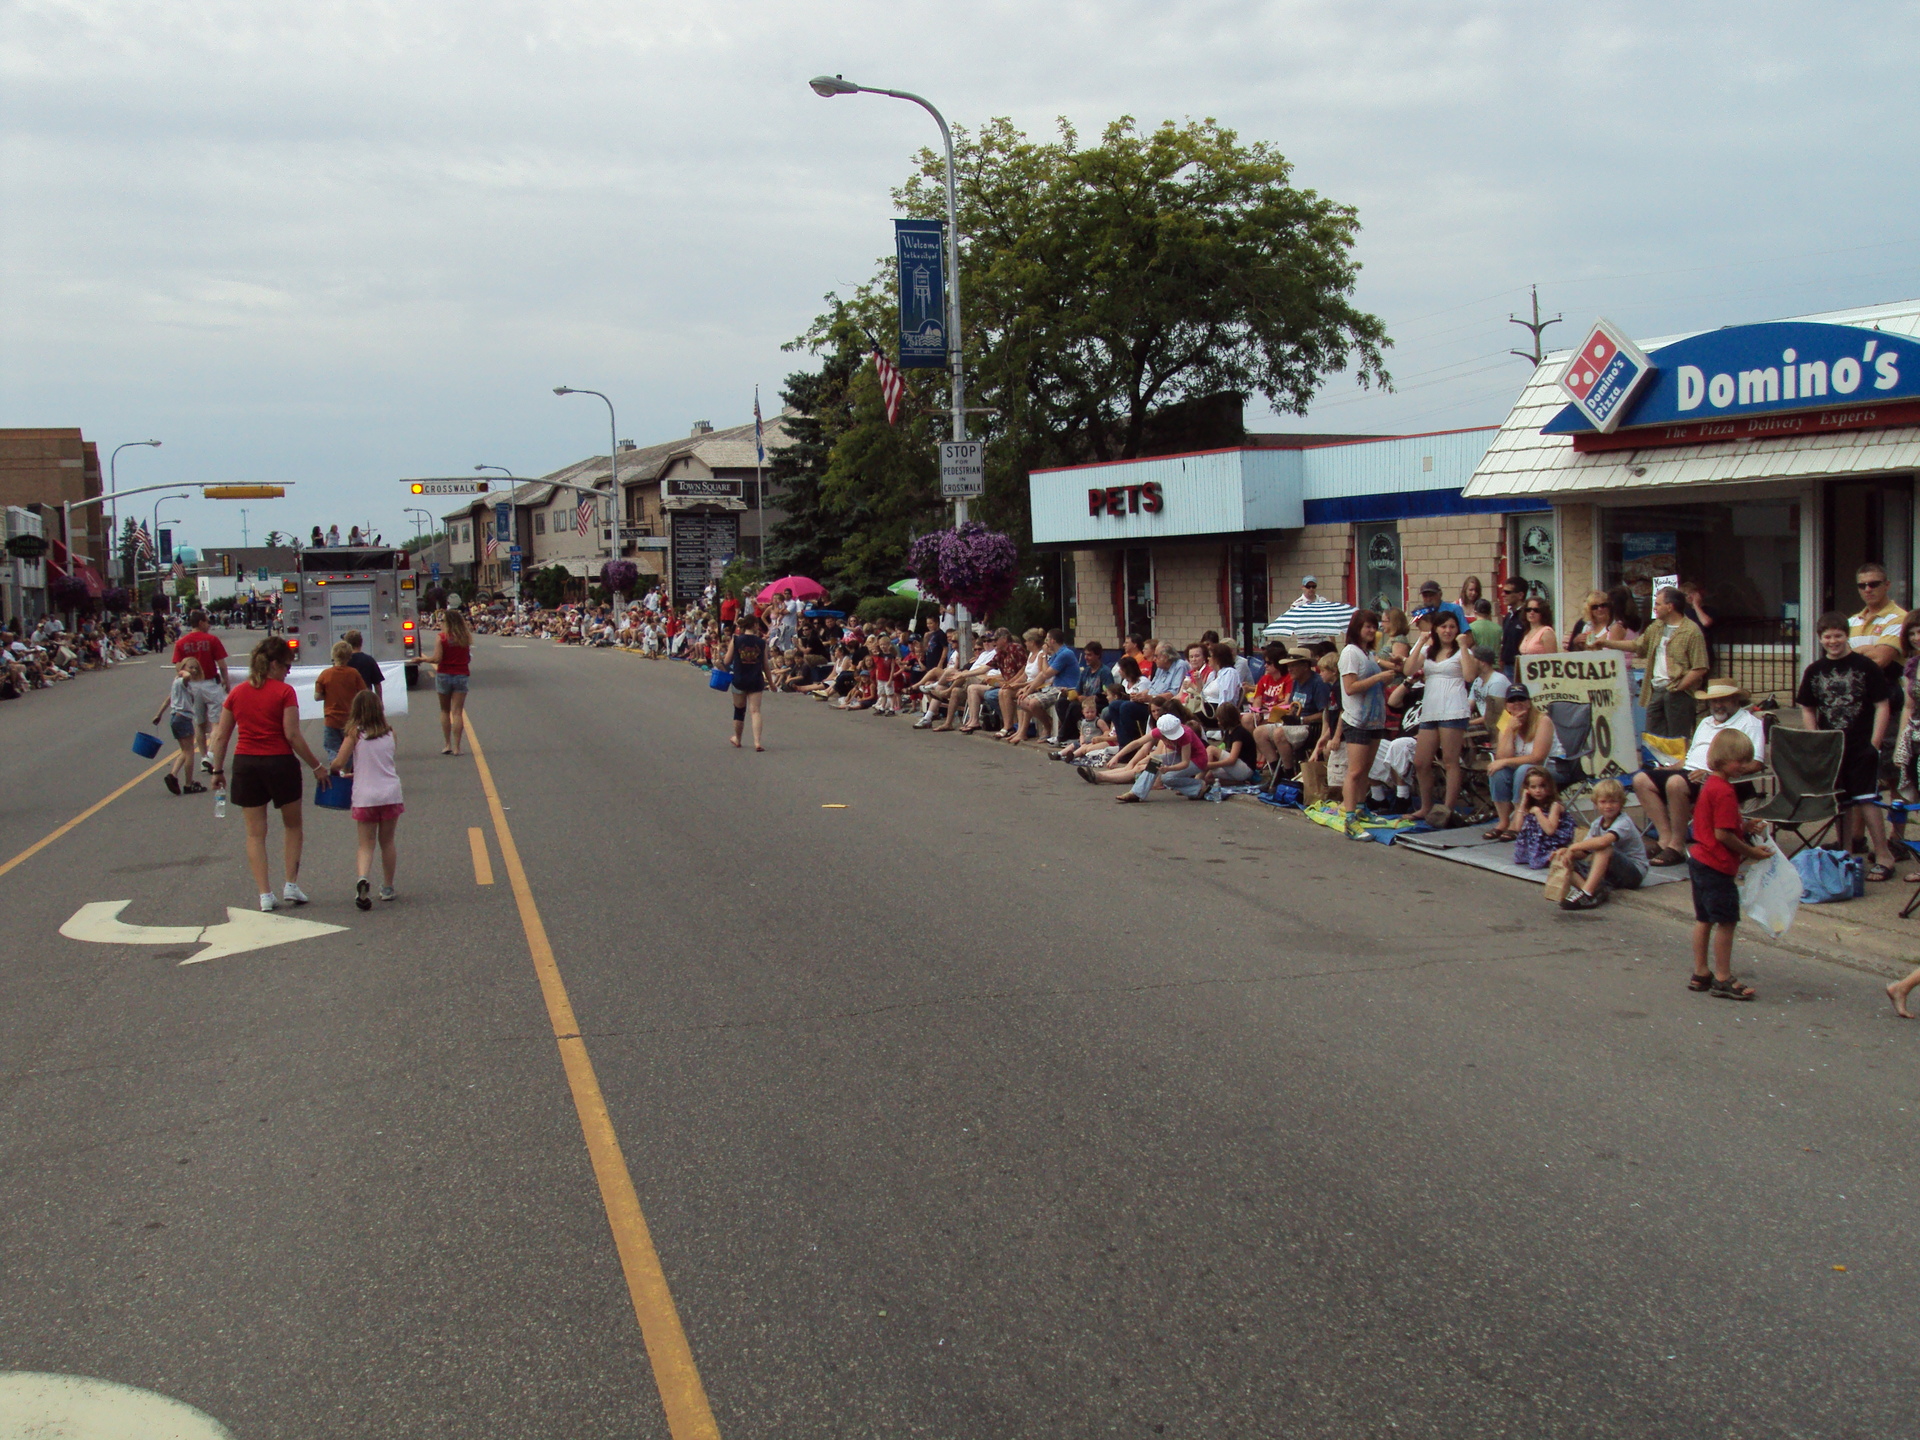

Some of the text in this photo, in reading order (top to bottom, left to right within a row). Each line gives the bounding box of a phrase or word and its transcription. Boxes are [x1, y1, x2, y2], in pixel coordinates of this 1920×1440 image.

[901, 235, 940, 250] Welcome
[1677, 340, 1899, 412] Domino's
[1586, 359, 1625, 410] Domino's
[1595, 386, 1621, 419] Pizza
[1665, 409, 1877, 439] The Pizza Delivery Experts
[946, 445, 977, 458] STOP
[943, 466, 981, 475] PEDESTRIAN
[424, 484, 475, 493] CROSSWALK
[677, 481, 731, 491] TOWN SQUARE
[943, 483, 982, 493] CROSSWALK
[1088, 482, 1164, 516] PETS
[1526, 659, 1617, 681] SPECIAL!
[1542, 683, 1549, 691] A
[1530, 692, 1580, 702] EPPERONI
[1587, 689, 1615, 708] WOW!
